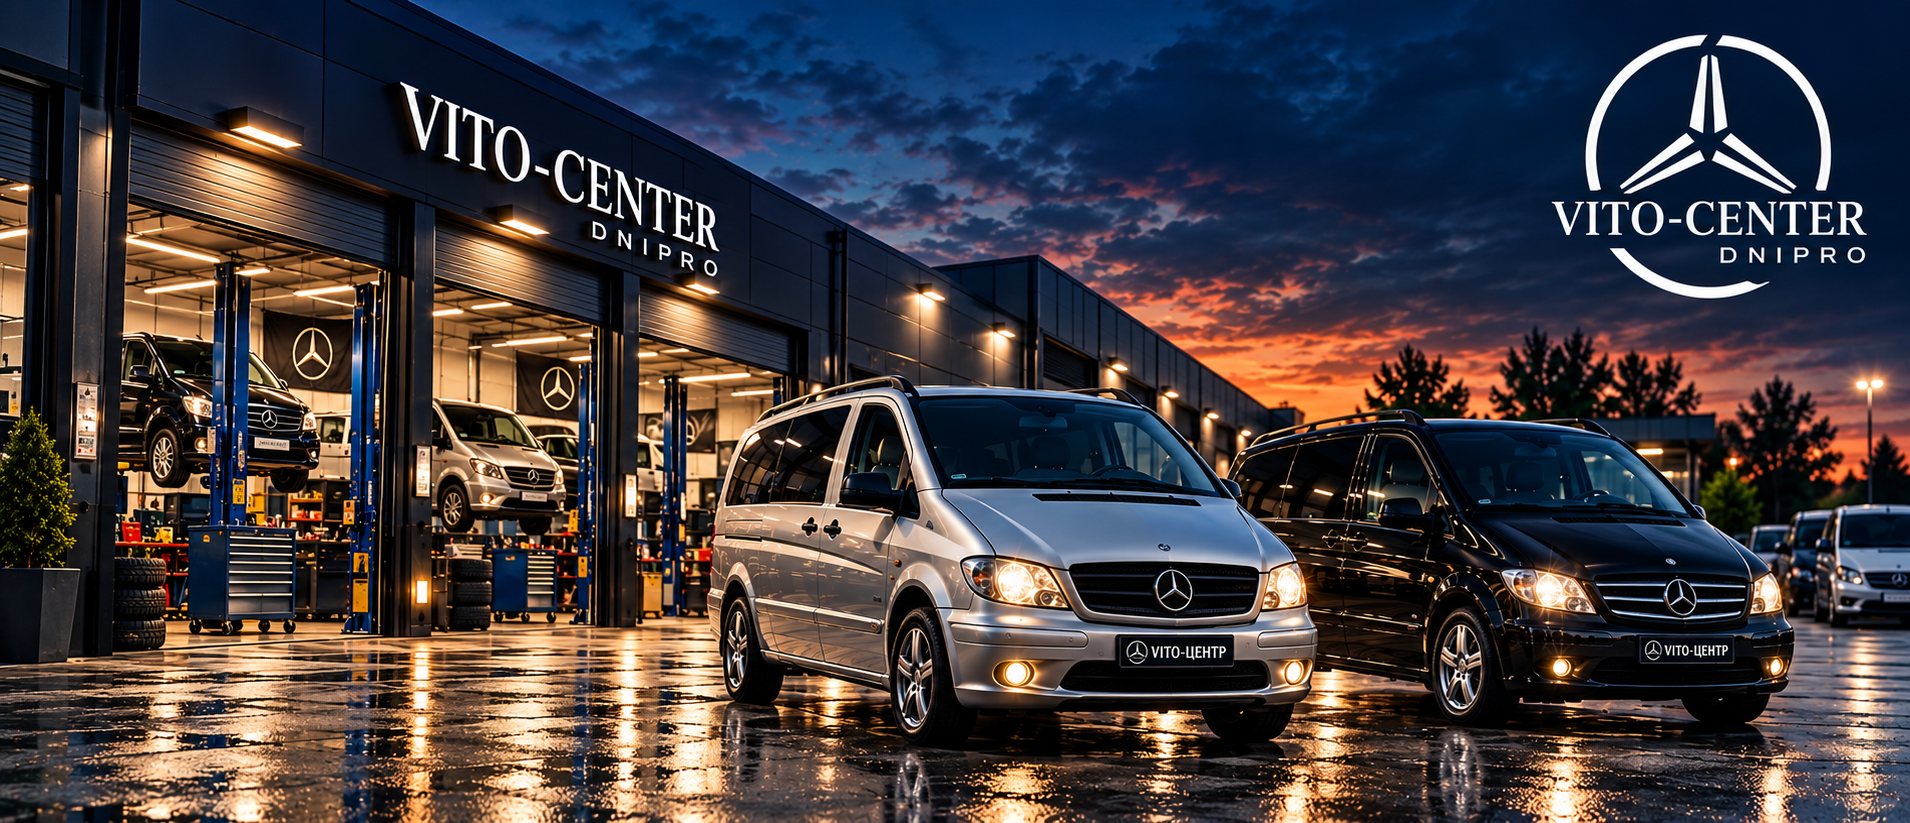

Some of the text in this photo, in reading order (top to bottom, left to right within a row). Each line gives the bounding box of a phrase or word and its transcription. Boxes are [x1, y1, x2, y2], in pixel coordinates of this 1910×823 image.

[400, 81, 720, 252] VITO-CENTER
[592, 220, 719, 278] DNIPRO
[1151, 645, 1227, 660] VITO-ЦЕНТР
[1664, 644, 1729, 658] VITO-ЦЕНТР
